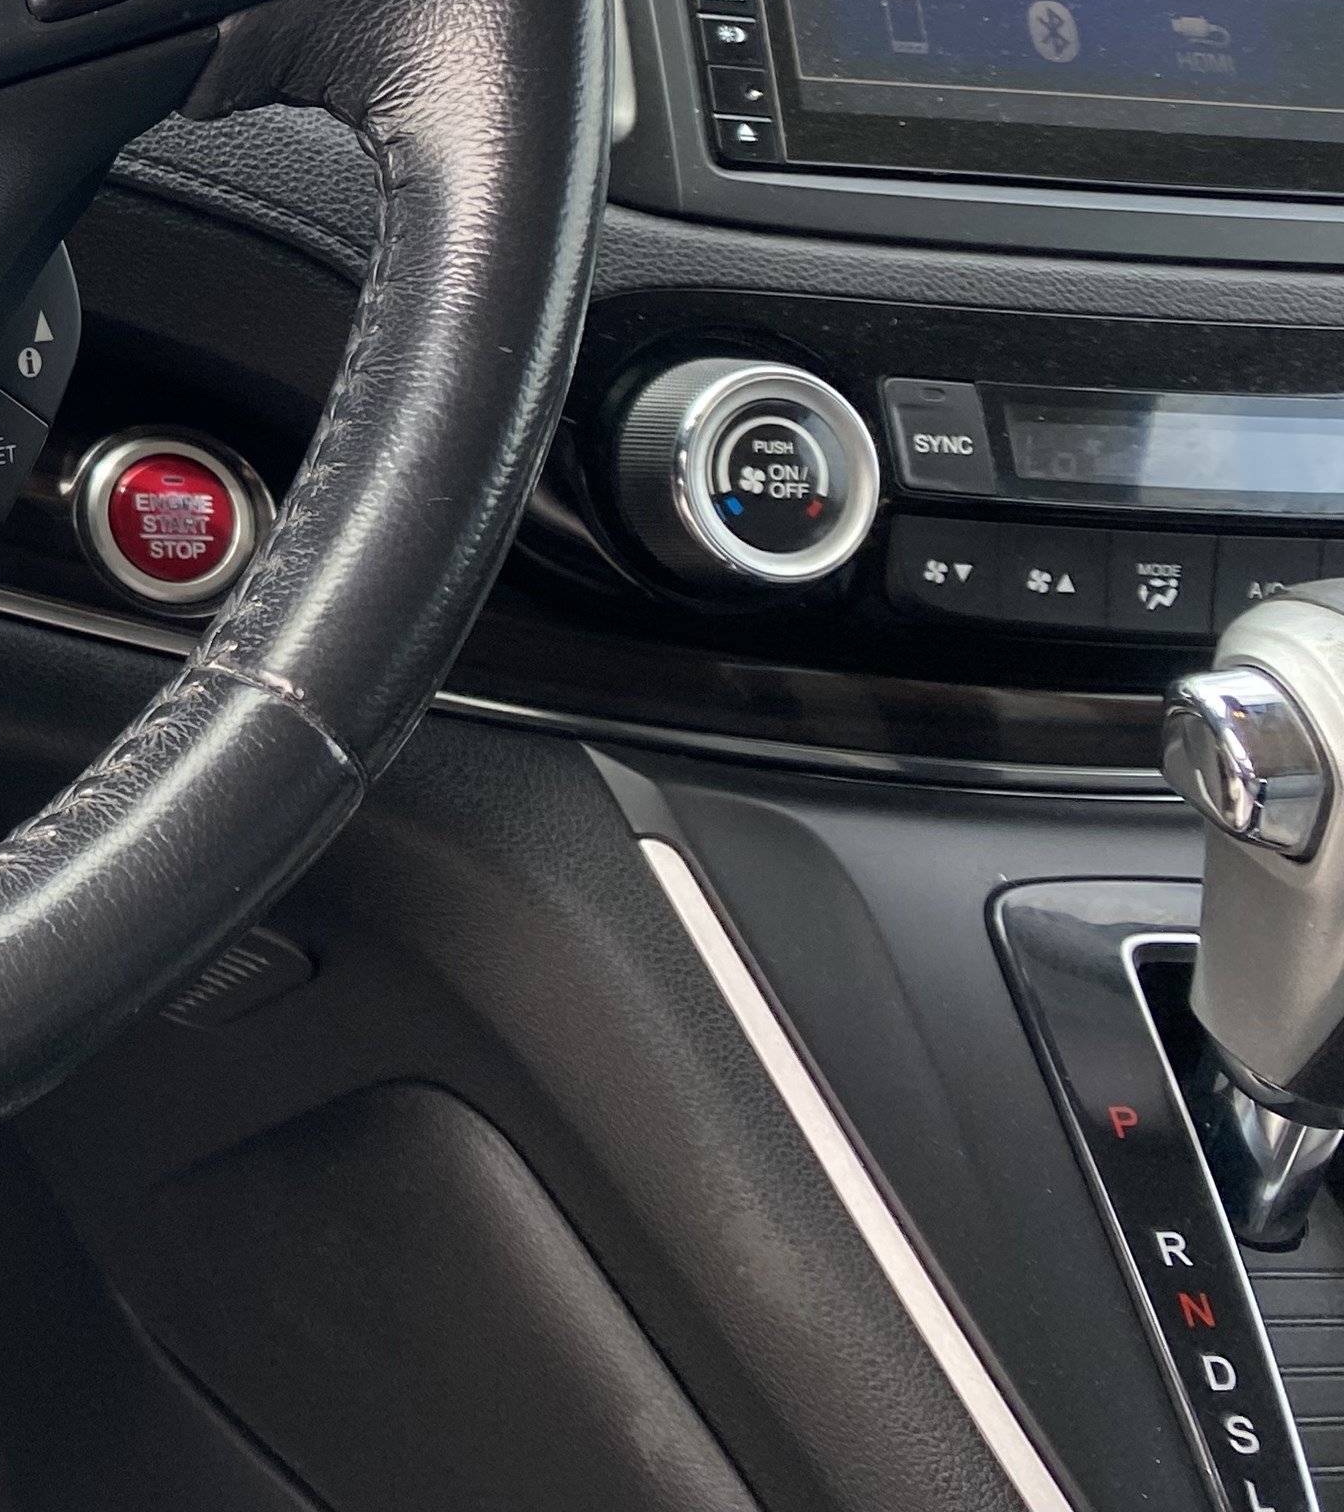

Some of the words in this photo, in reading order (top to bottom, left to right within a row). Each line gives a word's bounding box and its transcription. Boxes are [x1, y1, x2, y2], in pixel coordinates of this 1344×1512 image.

[1176, 51, 1237, 74] HDMI
[753, 439, 794, 455] PUSH
[914, 432, 975, 457] SYNC
[770, 482, 811, 499] OFF
[135, 492, 214, 515] ENGINE
[142, 515, 210, 536] START
[149, 540, 207, 560] STOP
[1136, 562, 1183, 578] MODE
[1108, 1105, 1139, 1140] P
[1155, 1230, 1194, 1267] R
[1178, 1292, 1216, 1328] N
[1202, 1354, 1238, 1391] D
[1223, 1415, 1261, 1455] S
[1243, 1479, 1276, 1512] L
